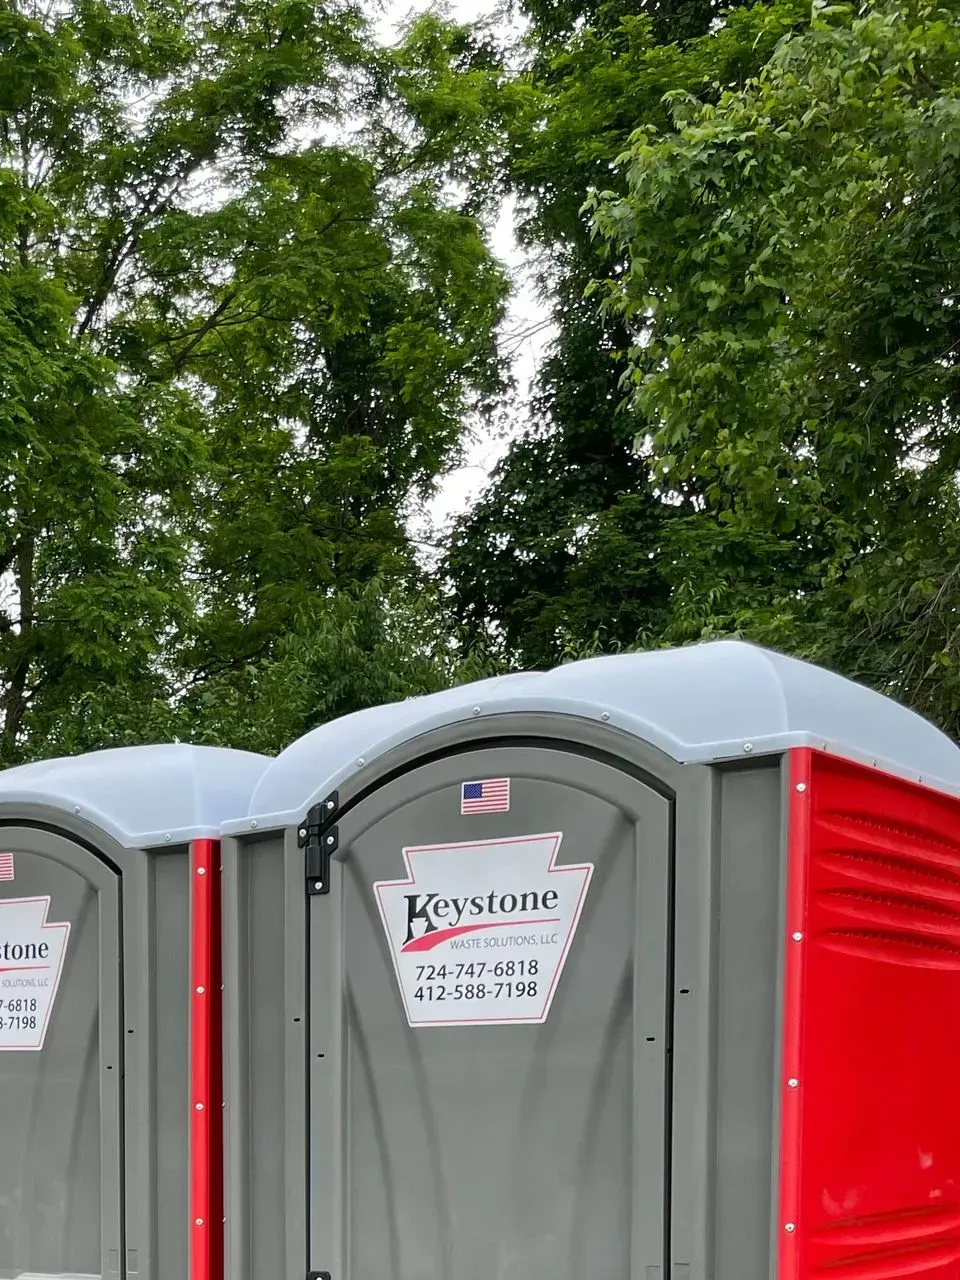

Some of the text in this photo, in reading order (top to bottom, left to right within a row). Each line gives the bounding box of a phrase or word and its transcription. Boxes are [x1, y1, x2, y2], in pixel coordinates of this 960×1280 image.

[403, 888, 559, 946] Keystone
[450, 933, 559, 950] WASTE SOLUTIONS, LLC
[415, 959, 539, 981] 724-747-6818
[38, 977, 49, 987] LLC
[414, 981, 538, 1002] 412-588-7198
